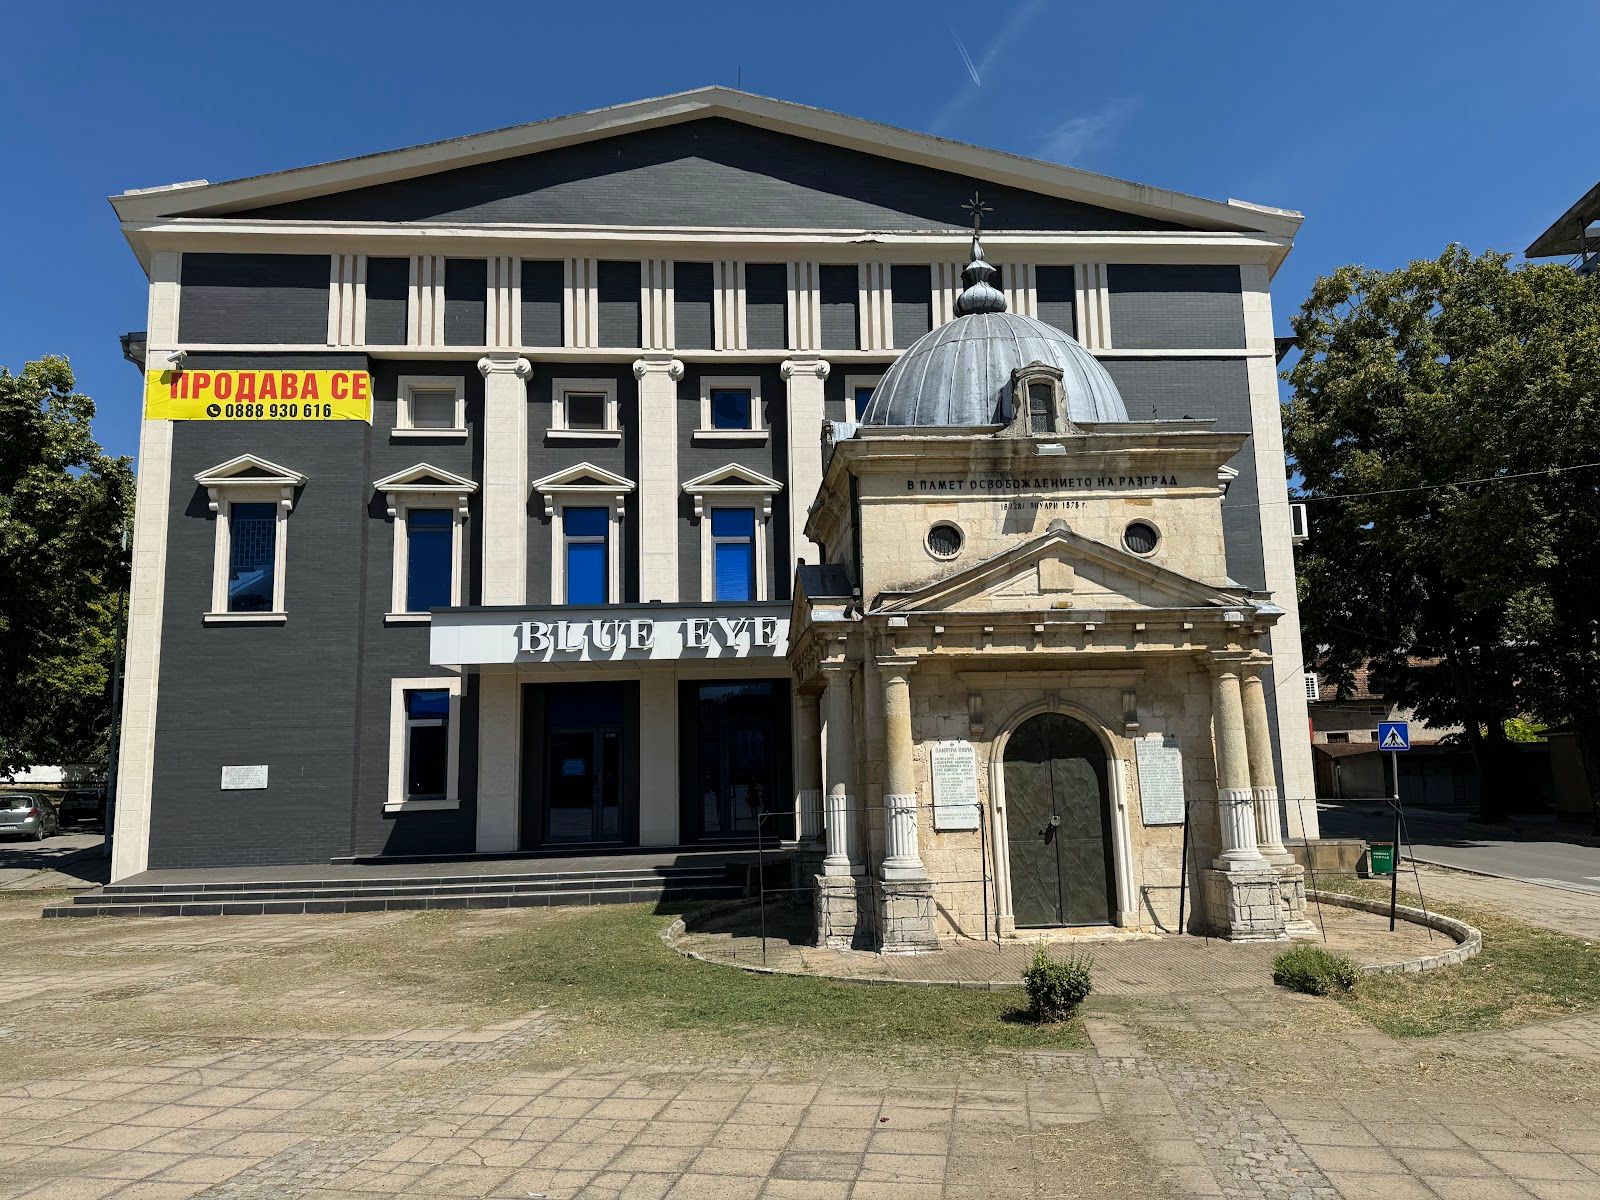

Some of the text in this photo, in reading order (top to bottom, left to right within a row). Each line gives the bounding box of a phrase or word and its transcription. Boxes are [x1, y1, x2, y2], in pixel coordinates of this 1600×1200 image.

[170, 372, 367, 403] ПРОДАВА СЕ
[225, 403, 332, 418] 0888 930 616
[907, 475, 1178, 490] В ПАМЕТ ОСВОБОЖДЕНИЕТО НА РАЗГРАД
[1030, 501, 1059, 511] ЯНУАРИ
[520, 616, 779, 651] BLUE EYE
